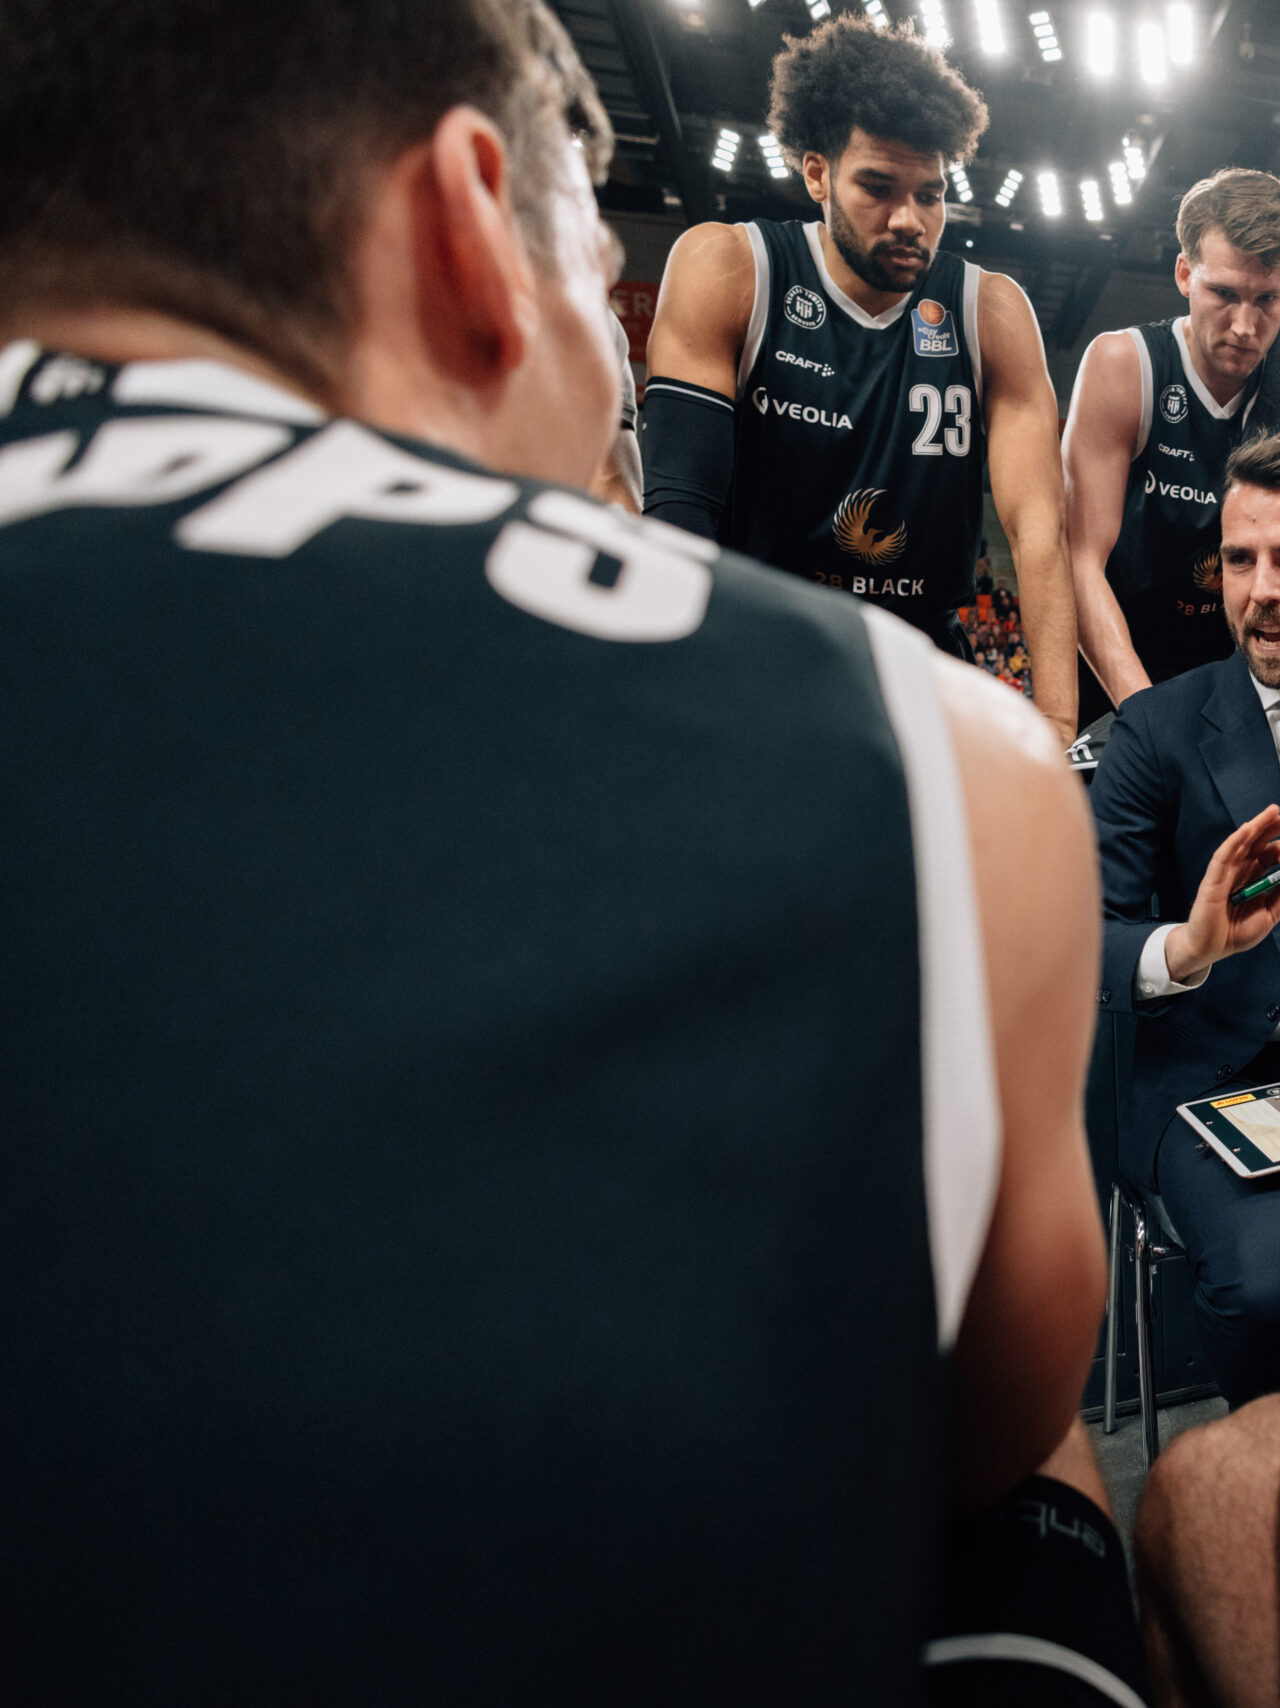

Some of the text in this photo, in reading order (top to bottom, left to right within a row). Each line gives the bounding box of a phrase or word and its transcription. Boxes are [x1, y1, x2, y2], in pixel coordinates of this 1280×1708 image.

[919, 338, 952, 352] BBL
[775, 350, 823, 373] CRAFT
[772, 398, 854, 430] VEOLIA
[908, 383, 972, 457] 23
[1158, 443, 1190, 459] CRAFT
[1159, 481, 1218, 505] VEOLIA
[852, 576, 925, 596] BLACK
